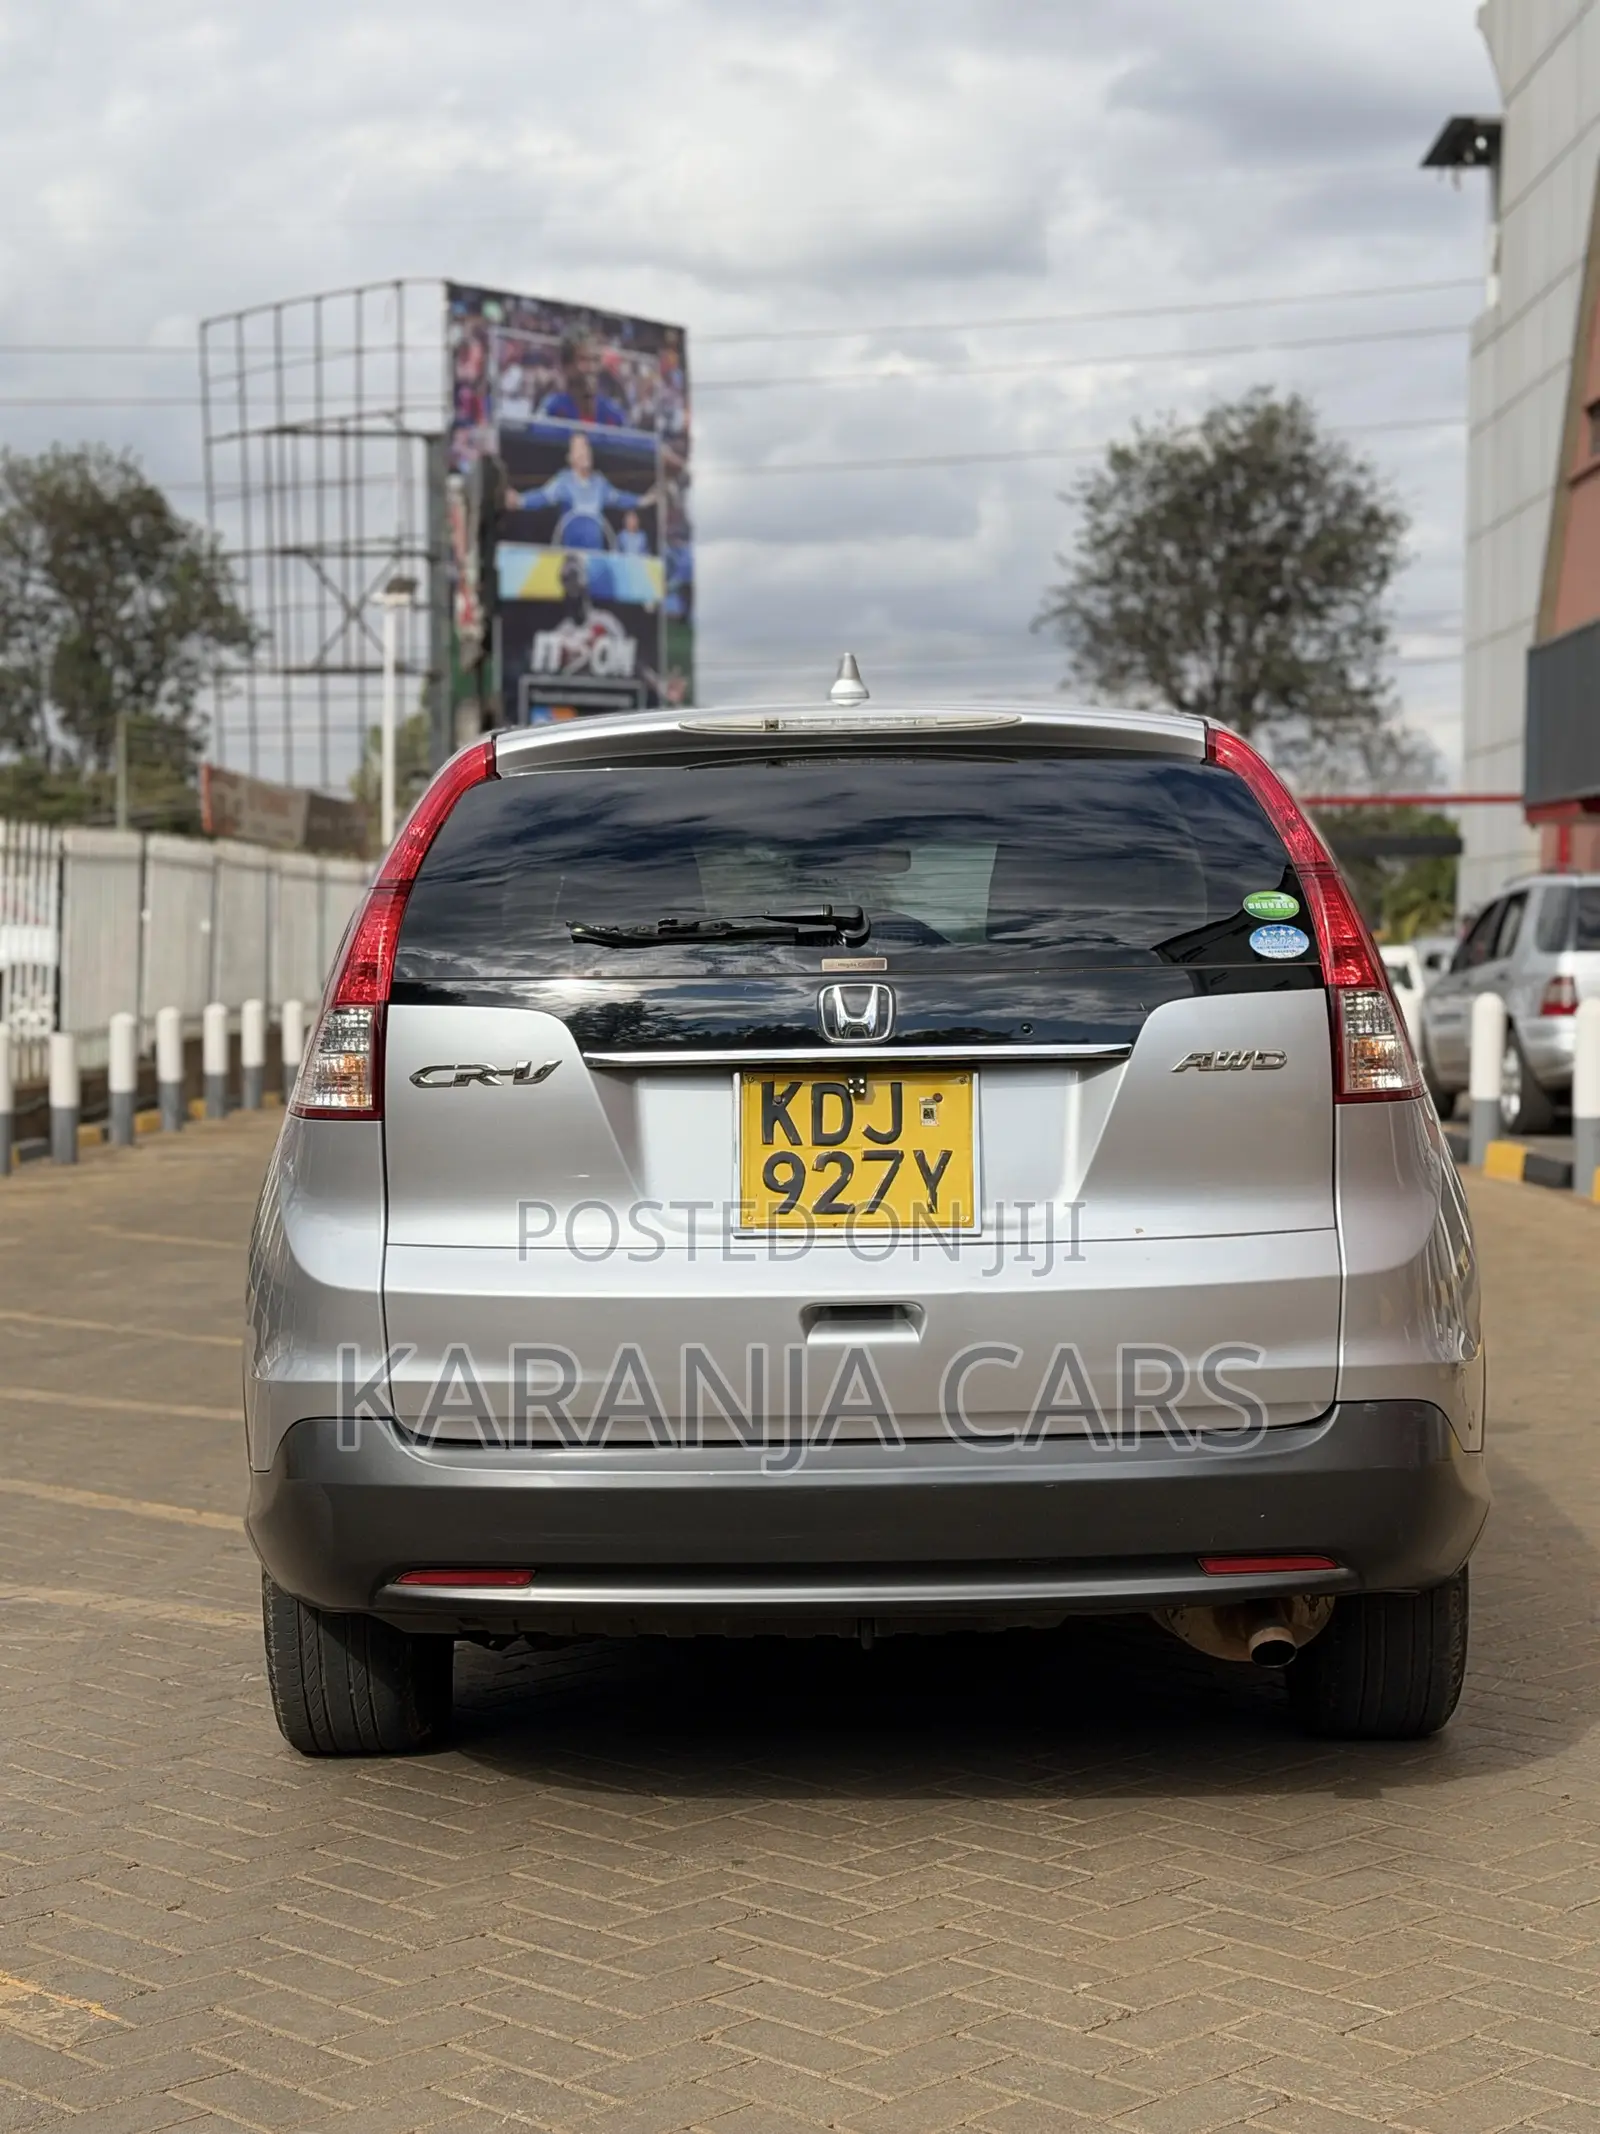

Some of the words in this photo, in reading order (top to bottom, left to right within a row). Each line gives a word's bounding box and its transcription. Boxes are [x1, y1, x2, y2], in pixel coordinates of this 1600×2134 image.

[409, 1060, 562, 1088] CR-V
[1170, 1049, 1288, 1073] AWD
[761, 1081, 903, 1146] KDJ
[762, 1150, 953, 1214] 927Y
